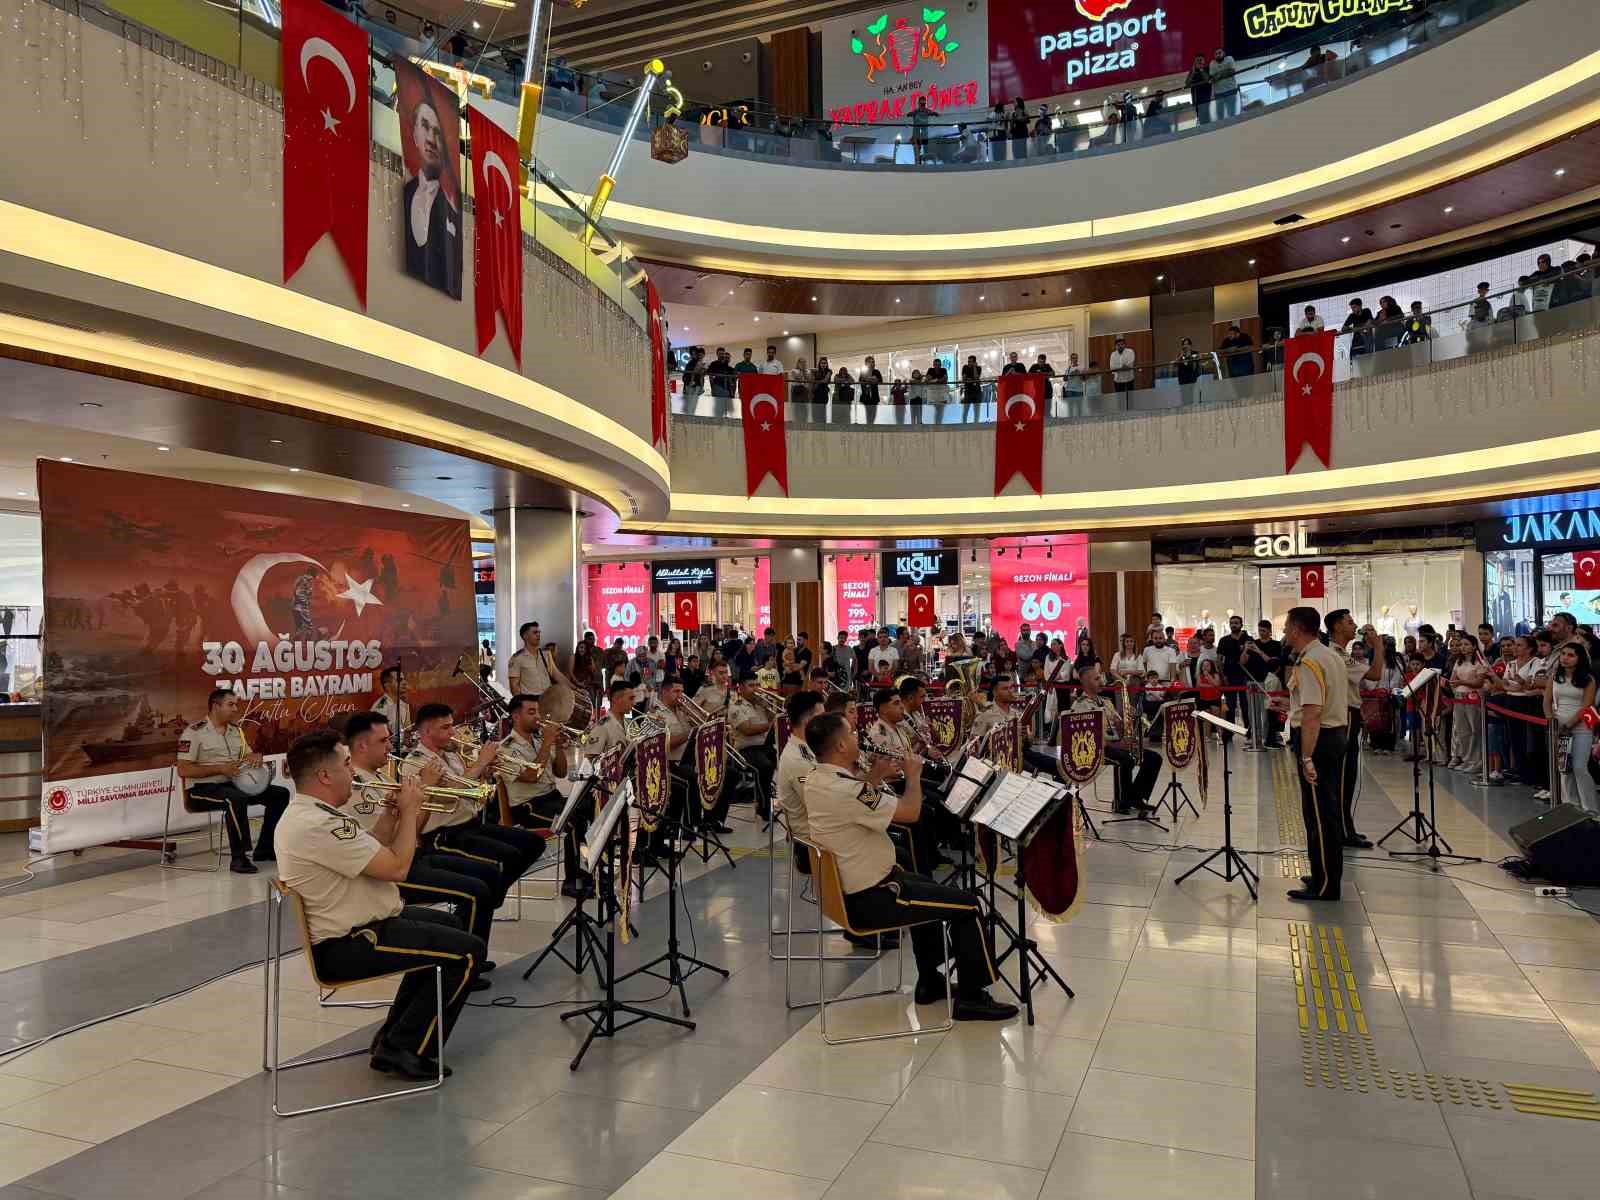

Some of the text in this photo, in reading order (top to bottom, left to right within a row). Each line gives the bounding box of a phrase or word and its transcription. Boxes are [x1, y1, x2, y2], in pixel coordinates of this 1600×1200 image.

[1040, 8, 1167, 60] pasaport
[1244, 3, 1319, 38] CAJUN
[1067, 50, 1136, 85] pizza
[602, 587, 624, 595] SEZON
[842, 582, 870, 590] SEZON
[1013, 574, 1041, 582] SEZON
[201, 632, 383, 676] 30 AĞUSTOS
[290, 672, 373, 698] BAYRAMI
[237, 692, 361, 727] Kutlu Olsun
[100, 790, 137, 802] SAVUNMA
